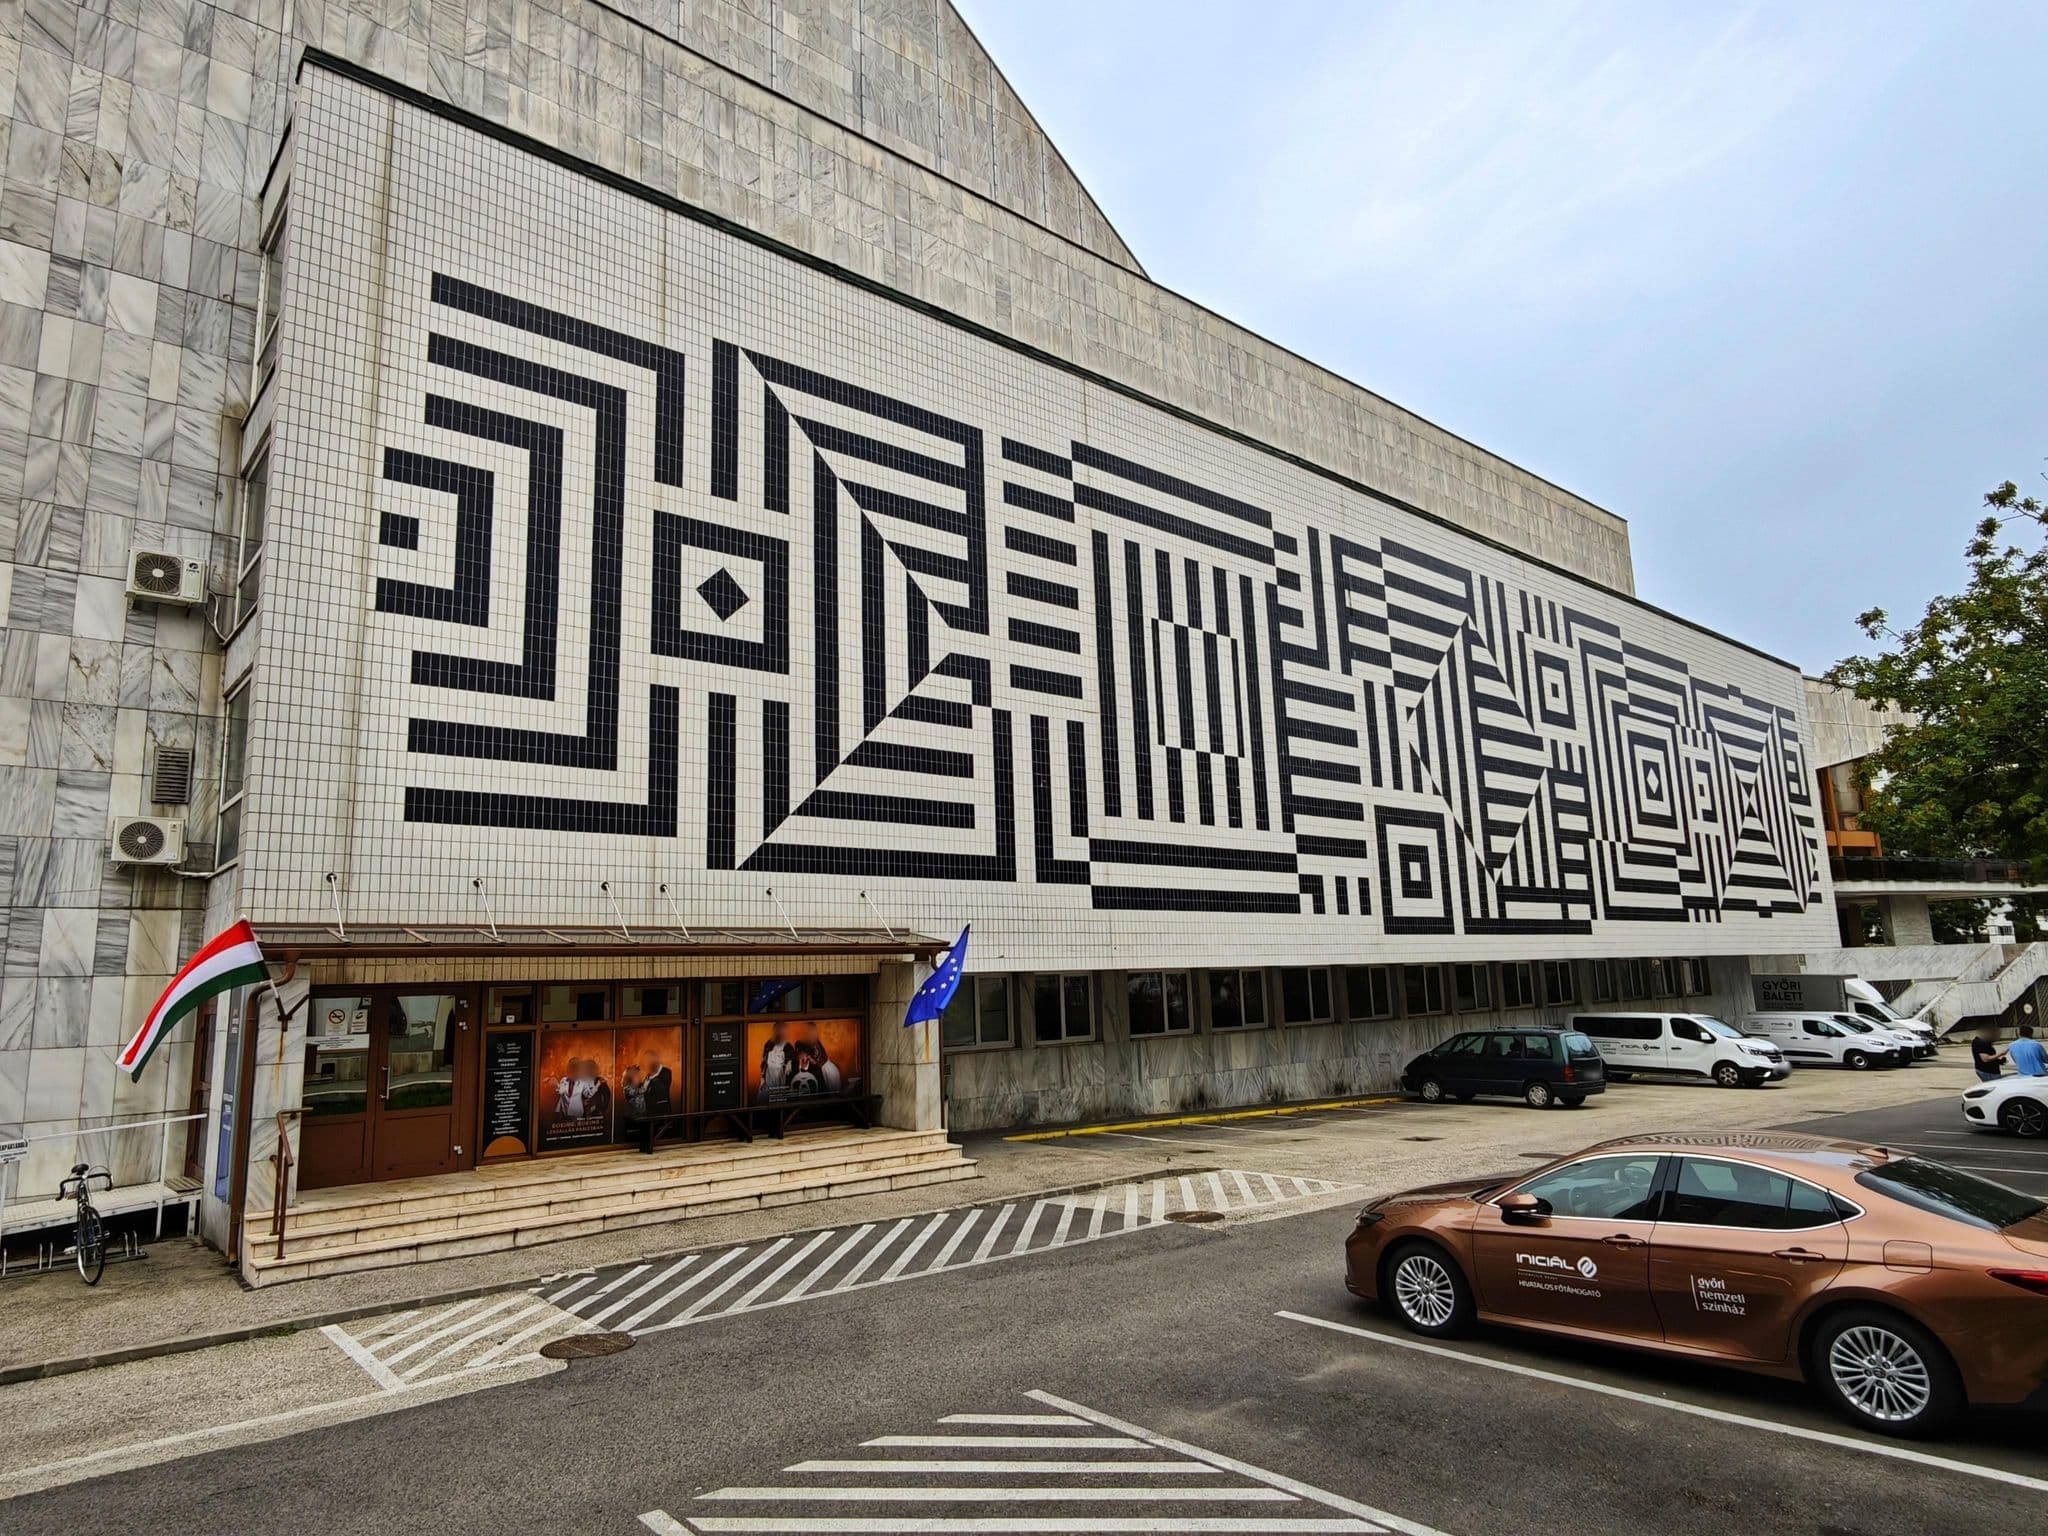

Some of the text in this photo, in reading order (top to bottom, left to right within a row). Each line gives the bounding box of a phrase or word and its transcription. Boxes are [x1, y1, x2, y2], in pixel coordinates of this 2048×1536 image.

[1762, 978, 1801, 991] GYŐRI
[1763, 991, 1804, 1001] BALETT
[1519, 1280, 1601, 1298] HIVATALOS FŐTÁMOGATÓ
[1697, 1277, 1725, 1289] győri
[1700, 1290, 1746, 1304] nemzeti
[1702, 1300, 1747, 1316] színház
